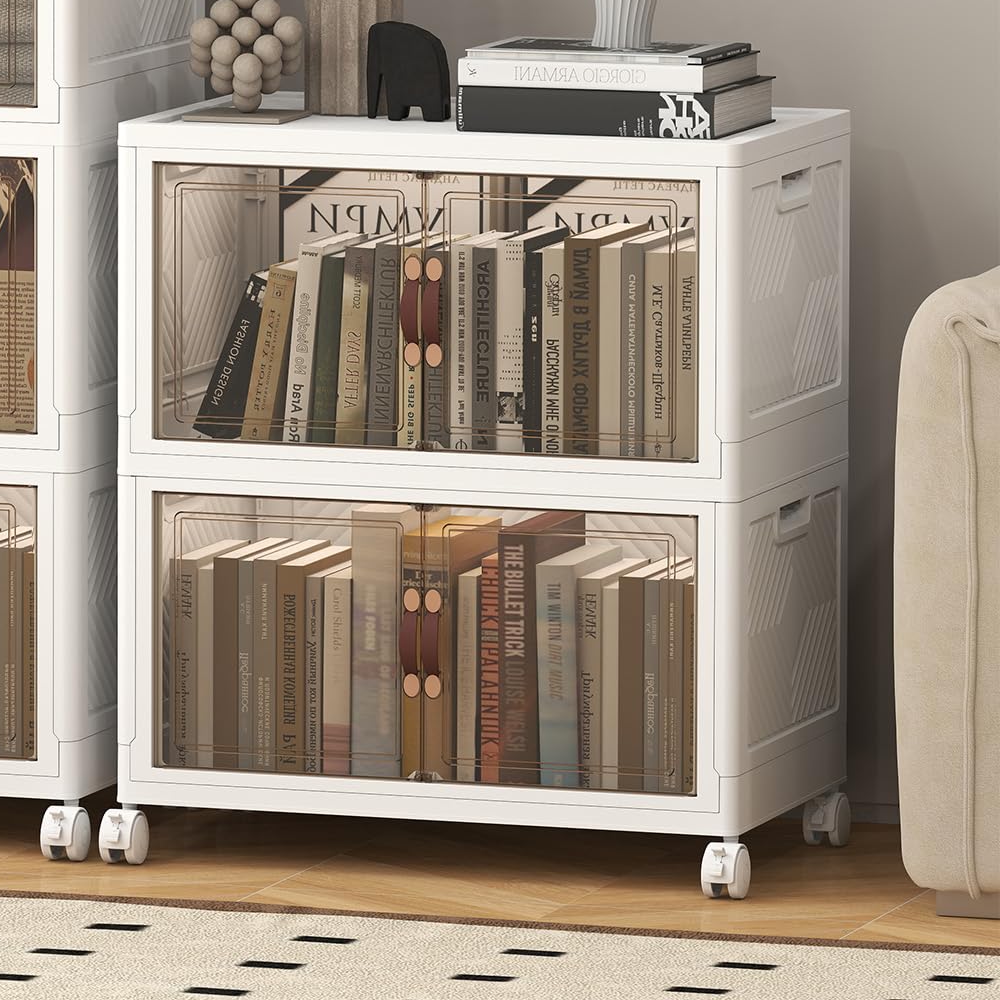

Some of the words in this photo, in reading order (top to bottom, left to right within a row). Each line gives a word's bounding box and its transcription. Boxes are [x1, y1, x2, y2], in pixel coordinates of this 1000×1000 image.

[503, 544, 524, 567] THE
[332, 588, 343, 613] Carol
[504, 569, 524, 617] BULLET
[546, 583, 561, 600] TIM
[332, 616, 343, 651] Shields
[504, 619, 524, 657] TRICK
[547, 604, 562, 641] WINTON
[548, 643, 562, 667] DIRT
[481, 648, 499, 745] PALAHNIUK
[505, 660, 527, 705] LOUISE
[548, 669, 563, 701] MUSIC
[505, 708, 527, 752] WELSH
